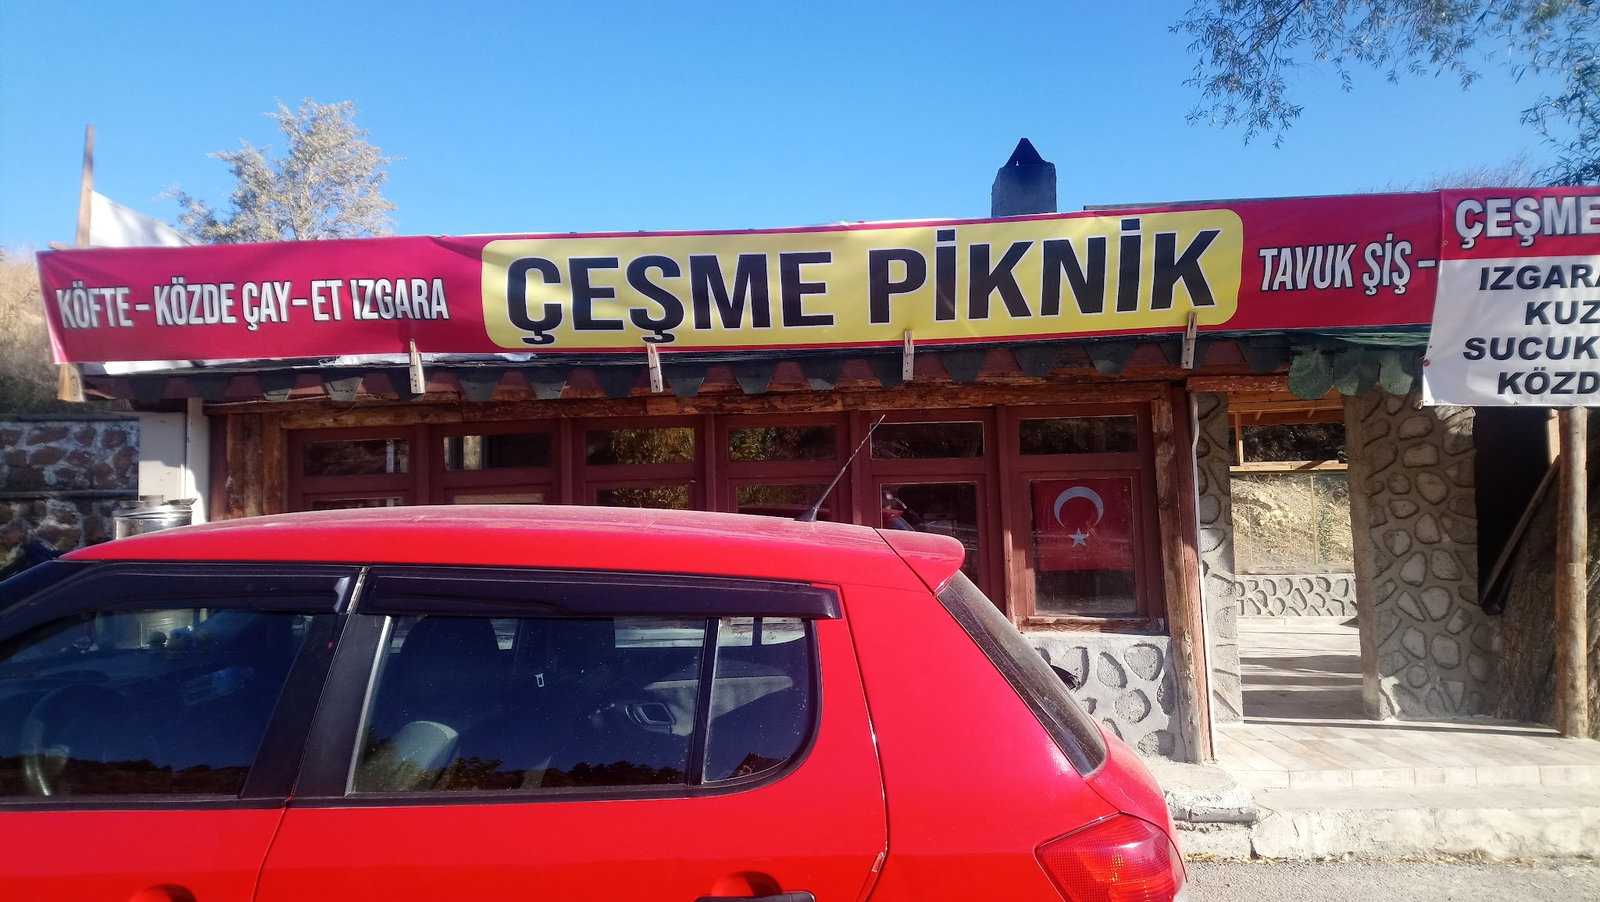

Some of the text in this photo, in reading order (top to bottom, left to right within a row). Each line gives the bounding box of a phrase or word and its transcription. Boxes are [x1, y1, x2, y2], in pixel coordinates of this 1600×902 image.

[1455, 196, 1600, 249] ÇEŞME
[506, 217, 1221, 345] ÇEŞME PİKNİK
[1258, 243, 1357, 291] TAVUK
[1362, 233, 1412, 295] ŞİŞ
[1479, 263, 1600, 290] IZGAR
[350, 278, 450, 321] IZGARA
[1462, 335, 1600, 361] SUCUK
[1497, 366, 1600, 395] KÖZD
